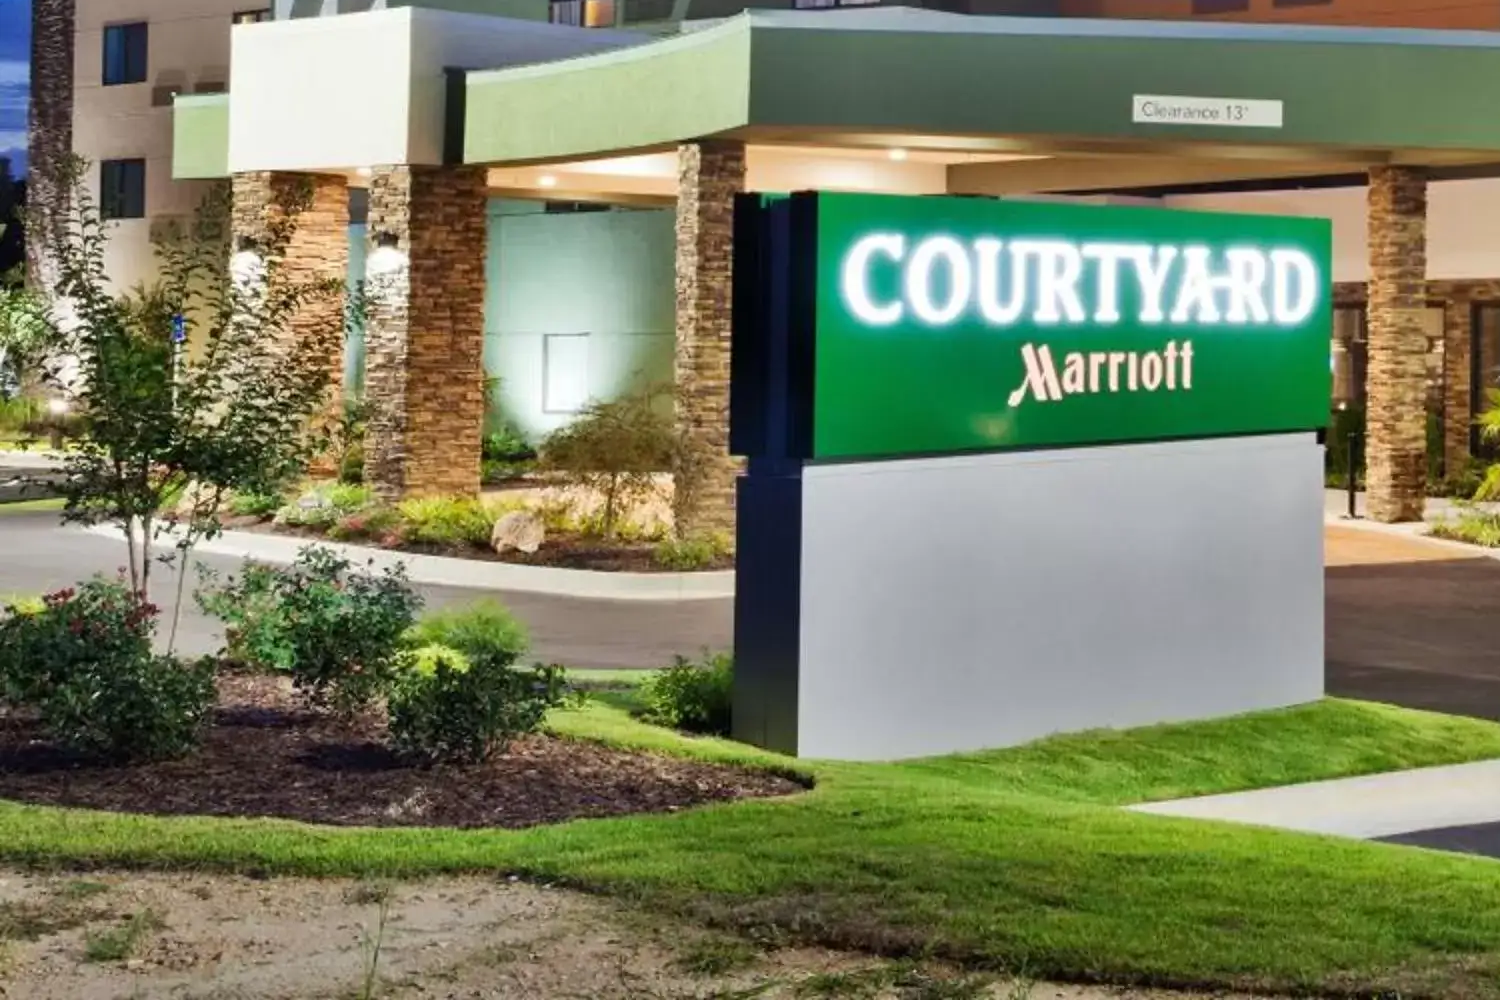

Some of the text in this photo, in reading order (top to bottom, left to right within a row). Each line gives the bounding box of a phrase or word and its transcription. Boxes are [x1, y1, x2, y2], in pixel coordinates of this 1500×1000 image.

[1142, 102, 1219, 119] Clearance
[842, 232, 1319, 325] COURTYARD
[1007, 340, 1194, 407] Marriott
